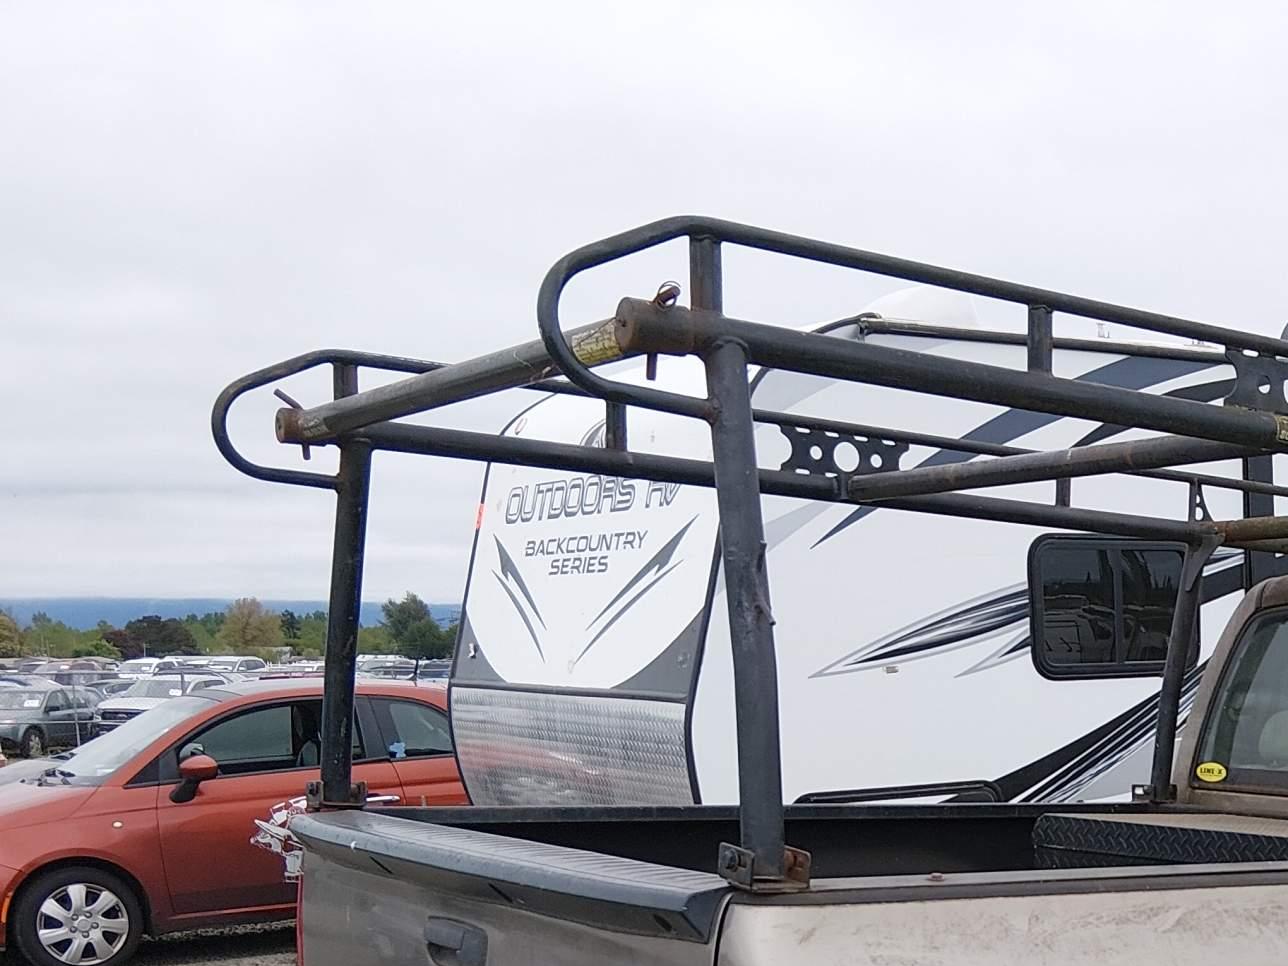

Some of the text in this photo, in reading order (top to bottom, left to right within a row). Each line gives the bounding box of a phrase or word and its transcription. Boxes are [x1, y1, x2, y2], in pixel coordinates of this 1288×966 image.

[505, 475, 636, 524] OUTDOORS
[525, 530, 648, 557] BACKCOUNTRY
[548, 556, 609, 576] SERIES
